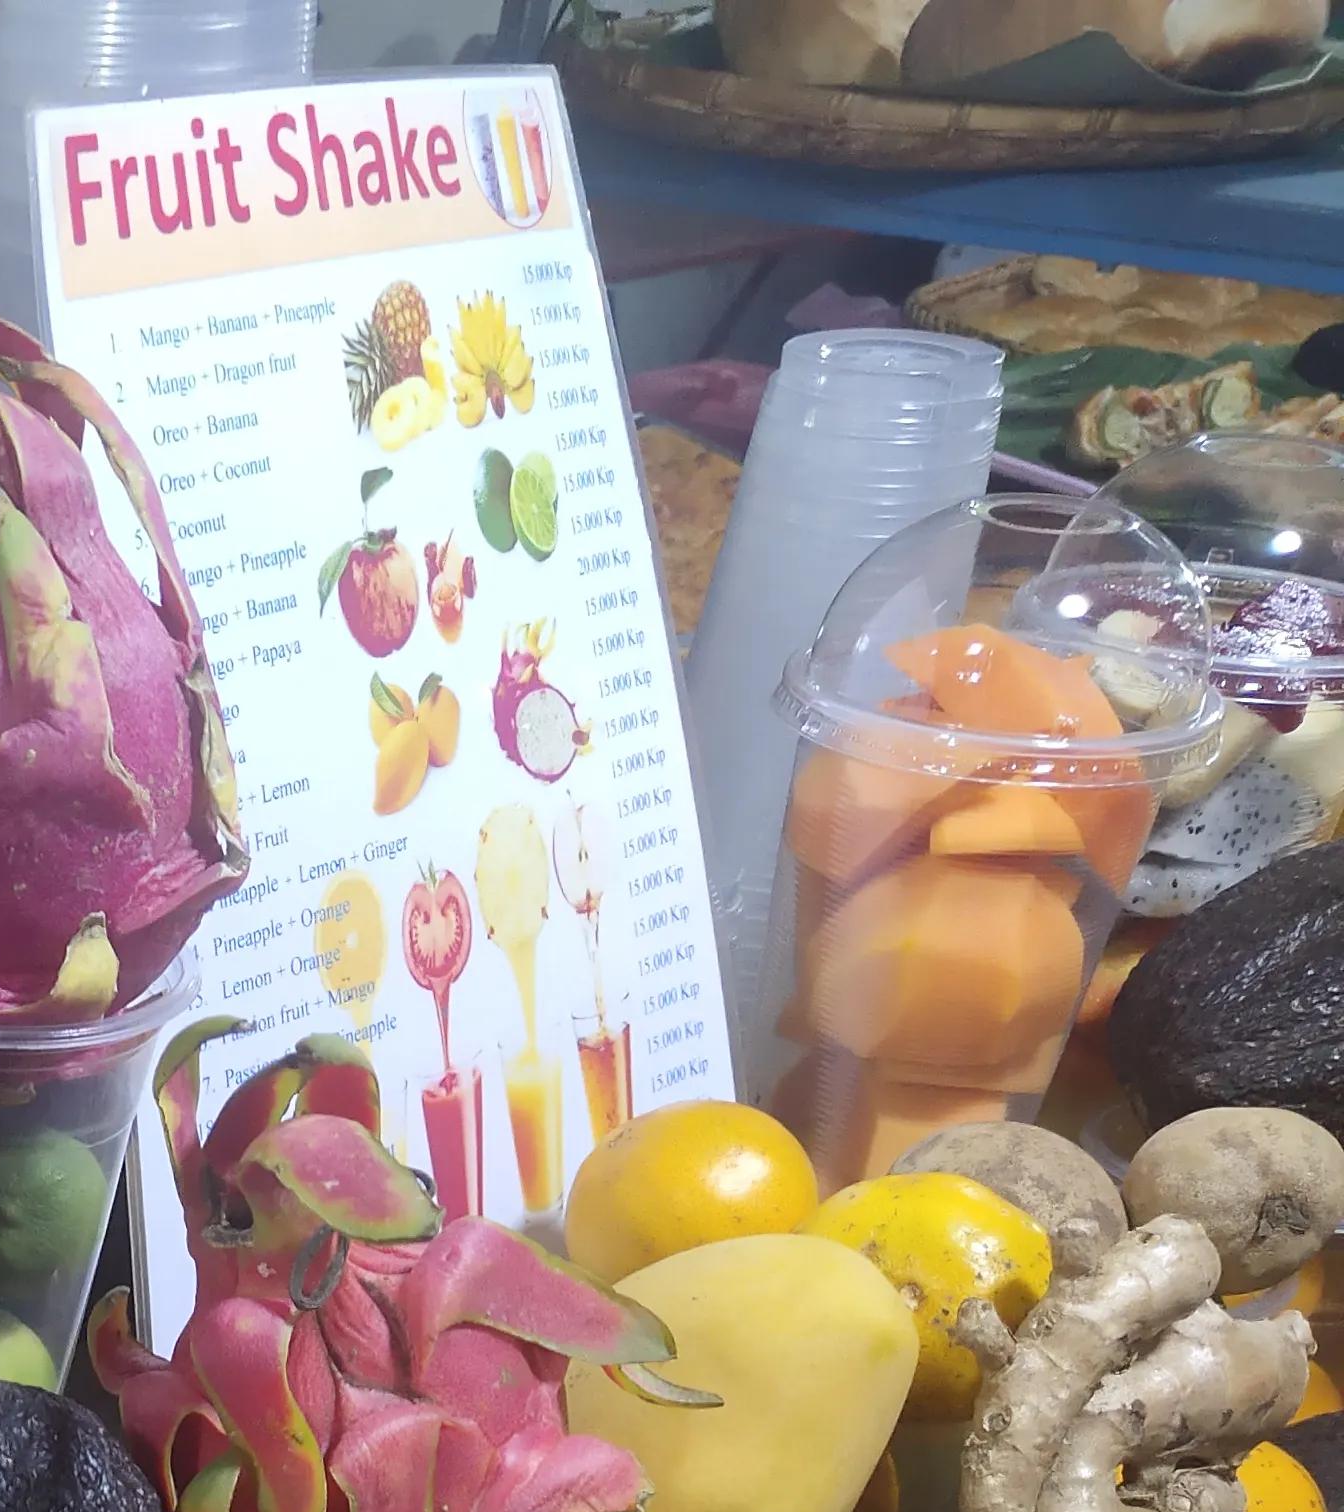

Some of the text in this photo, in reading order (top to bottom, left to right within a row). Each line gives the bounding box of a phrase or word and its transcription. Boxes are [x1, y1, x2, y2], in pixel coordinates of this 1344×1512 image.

[64, 97, 461, 246] Fruit Shake
[554, 261, 573, 283] Kip
[139, 326, 190, 348] Mango
[207, 313, 258, 336] Banana
[274, 296, 336, 325] Pineapple
[563, 302, 581, 323] Kip
[572, 344, 590, 364] Kip
[146, 376, 196, 397] Mango
[213, 360, 265, 385] Dragon
[268, 352, 297, 374] fruit
[580, 386, 598, 406] Kip
[153, 424, 189, 446] Oreo
[206, 411, 259, 435] Banana
[589, 426, 606, 446] Kip
[159, 473, 195, 494] Oreo
[213, 456, 272, 483] Coconut
[596, 466, 614, 486] Kip
[604, 508, 622, 527] Kip
[240, 541, 307, 574] Pineapple
[612, 549, 630, 568] Kip
[620, 589, 638, 607] Kip
[202, 611, 228, 634] ngo
[246, 594, 298, 619] Banana
[627, 628, 644, 648] Kip
[252, 639, 302, 667] Papaya
[633, 668, 652, 687] Kip
[640, 708, 658, 727] Kip
[647, 747, 665, 767] Kip
[261, 777, 311, 804] Lemon
[653, 787, 671, 806] Kip
[255, 826, 289, 852] Fruit
[659, 826, 677, 845] Kip
[218, 875, 279, 909] ineapple
[299, 856, 346, 884] Lemon
[363, 836, 408, 862] Ginger
[665, 865, 683, 884] Kip
[670, 904, 689, 924] Kip
[213, 919, 283, 957] Pineapple
[300, 900, 351, 928] Orange
[676, 943, 695, 962] Kip
[221, 971, 272, 1000] Lemon
[290, 947, 341, 976] Orange
[680, 982, 700, 1001] Kip
[280, 1000, 310, 1025] fruit
[327, 979, 376, 1008] Mango
[337, 1013, 397, 1043] neapple
[684, 1021, 704, 1039] Kip
[689, 1058, 709, 1076] Kip
